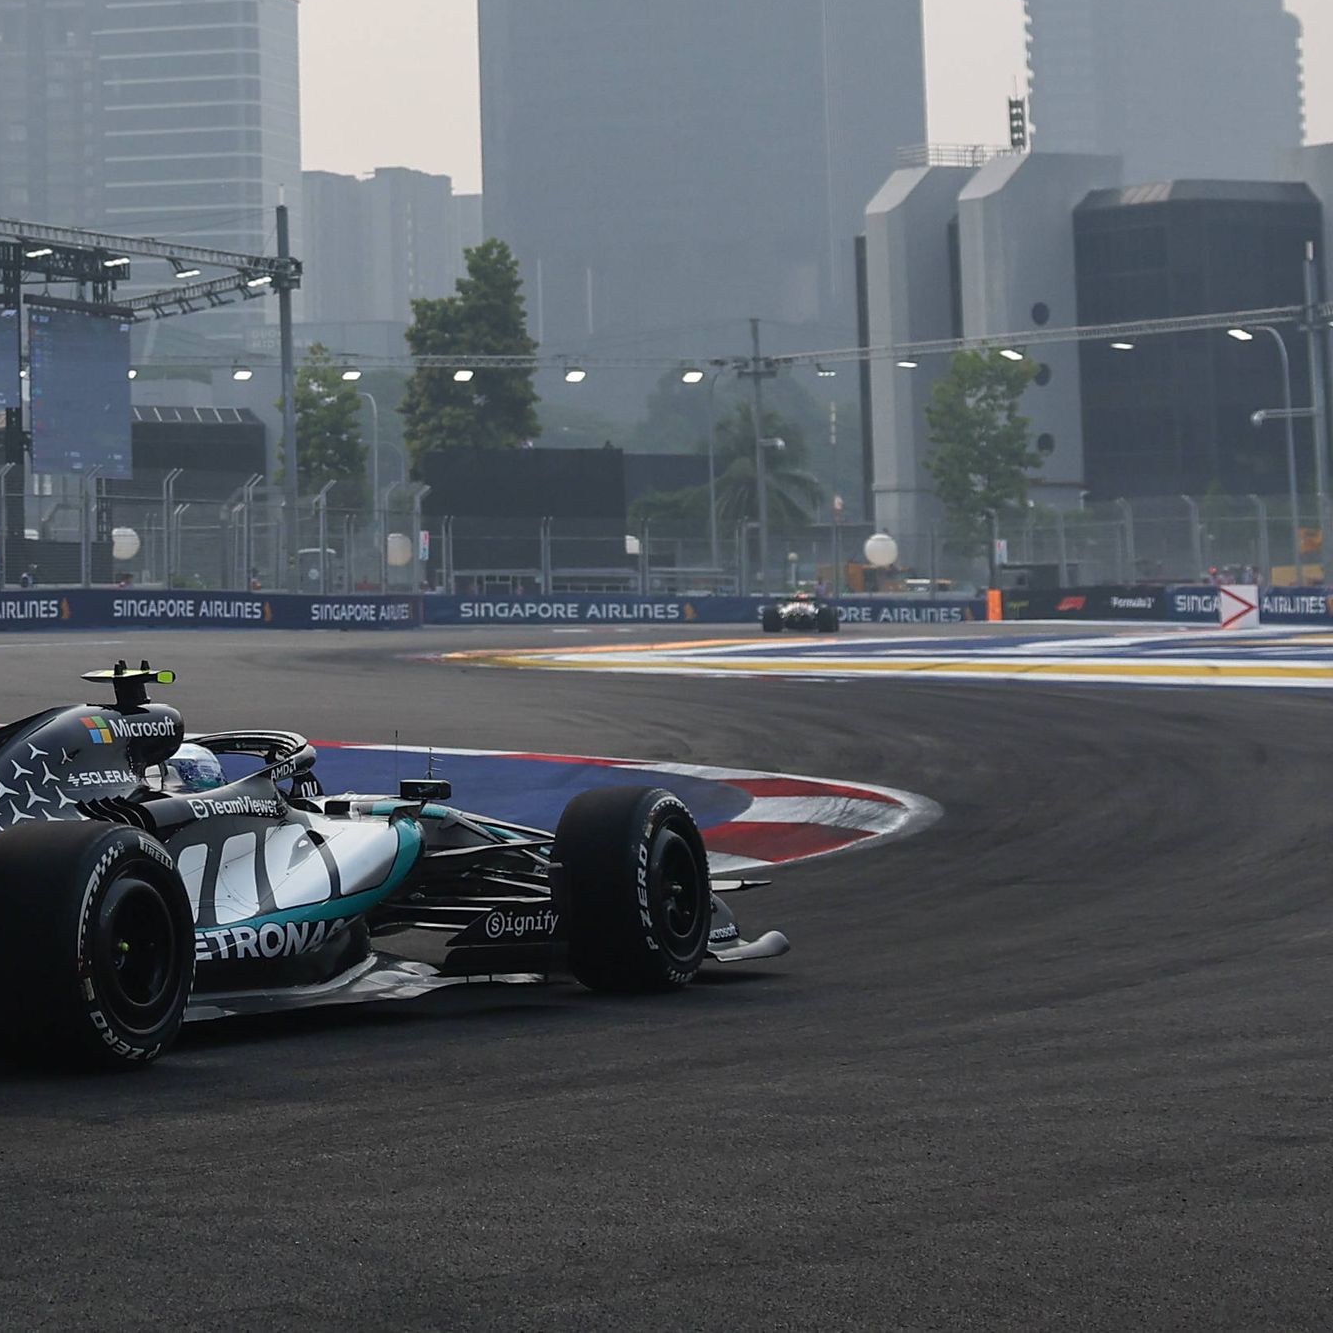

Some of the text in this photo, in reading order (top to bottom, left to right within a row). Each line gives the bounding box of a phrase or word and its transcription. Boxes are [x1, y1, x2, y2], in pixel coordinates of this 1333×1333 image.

[113, 599, 262, 619] SINGAPORE AIRLINES
[311, 603, 376, 622] SINGAPORE
[460, 602, 680, 619] SINGAPORE AIRLINES
[1175, 595, 1326, 614] SINGA AIRLINES
[879, 606, 962, 623] AIRLINES
[109, 716, 176, 738] Microsoft
[79, 769, 132, 786] SOLERA
[271, 764, 290, 780] AMD
[203, 796, 278, 815] TeamViewer
[138, 835, 173, 870] PIRELLI
[637, 843, 654, 929] ZERO
[90, 1010, 145, 1060] ZERO
